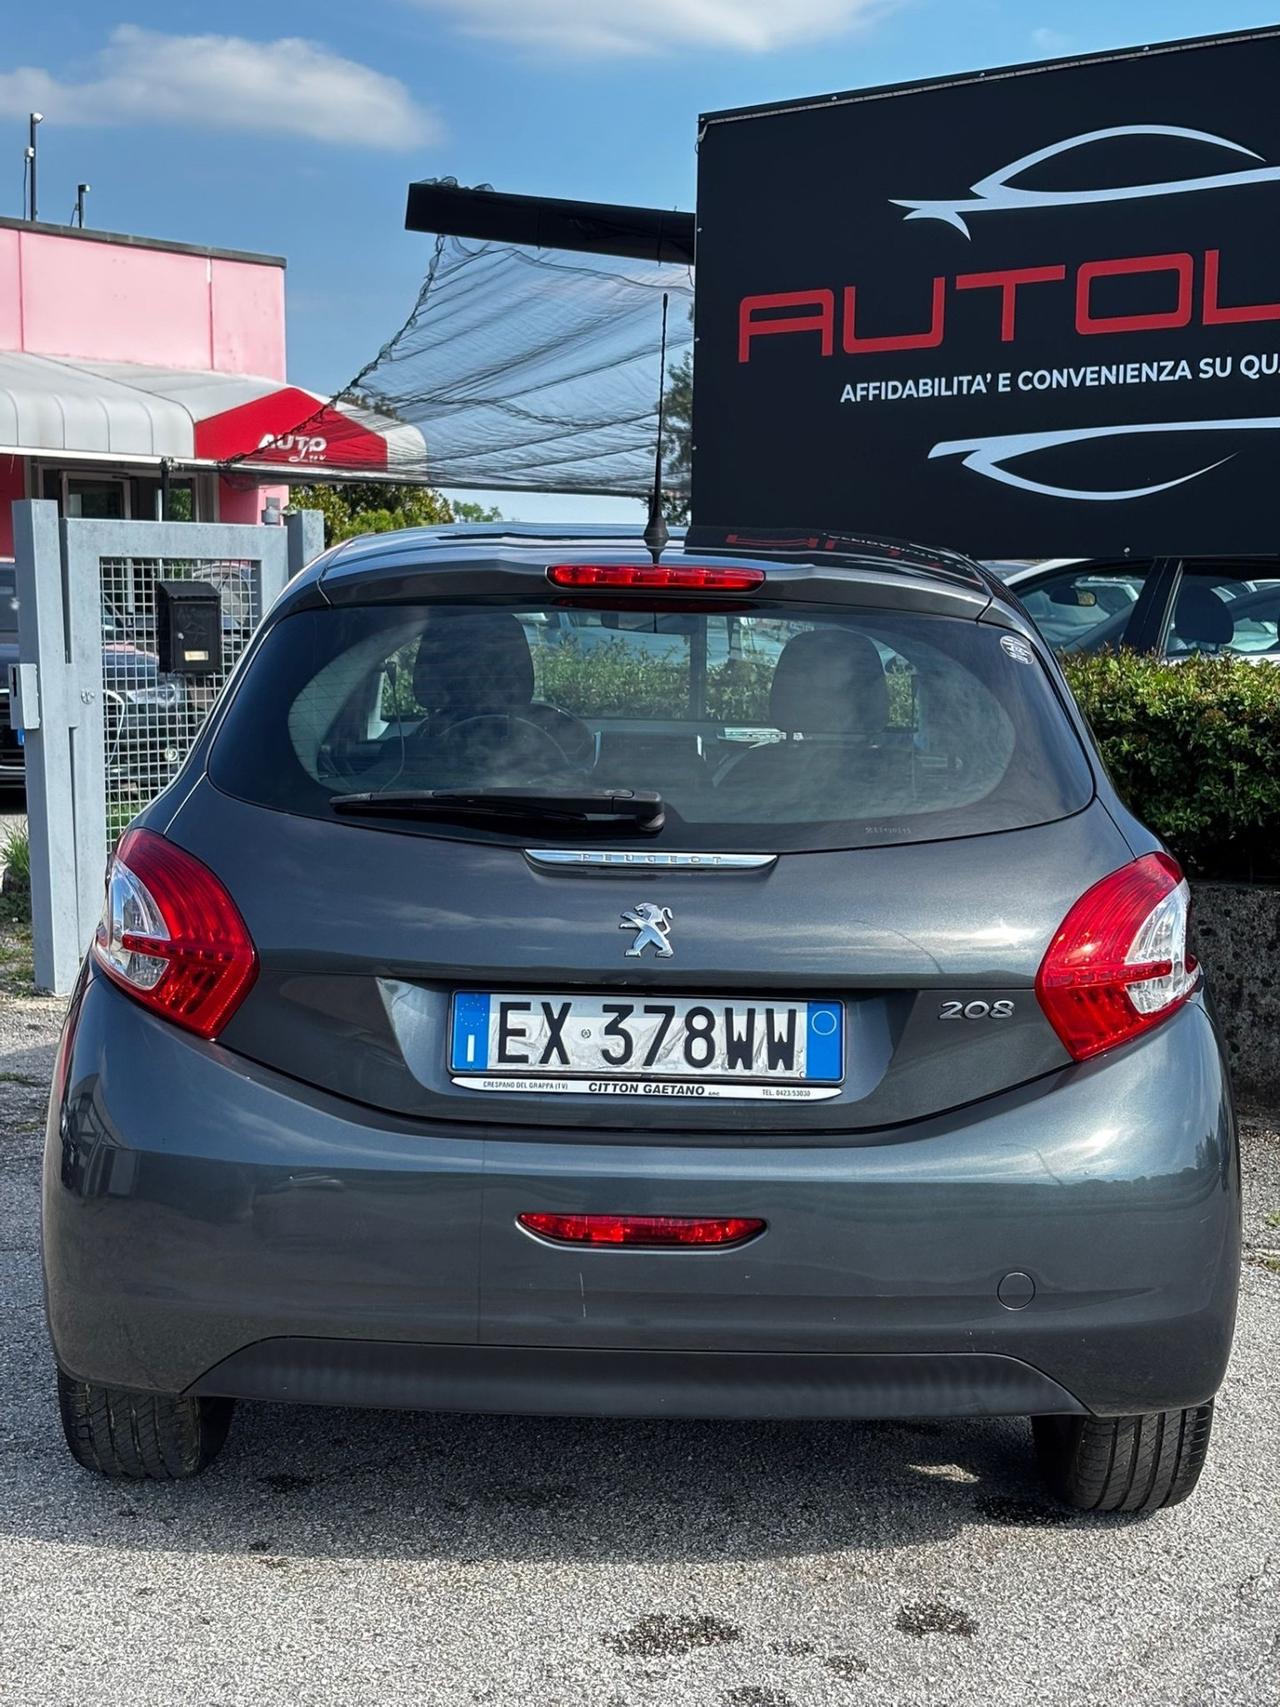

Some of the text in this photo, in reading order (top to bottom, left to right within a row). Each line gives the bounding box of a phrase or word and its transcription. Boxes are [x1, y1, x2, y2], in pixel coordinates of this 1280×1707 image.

[998, 372, 1012, 393] E
[1017, 358, 1193, 392] CONVENIENZA
[1198, 356, 1232, 379] SU
[1239, 352, 1280, 380] QU
[258, 433, 328, 452] AUTO
[580, 853, 722, 866] PEUGEOT
[938, 999, 1015, 1020] 208
[498, 1001, 573, 1065] EX
[601, 1004, 797, 1071] 378WW
[516, 1081, 527, 1089] DEL
[529, 1082, 554, 1090] GRAPPA
[588, 1082, 638, 1094] CITTON
[643, 1084, 705, 1096] GAETANO
